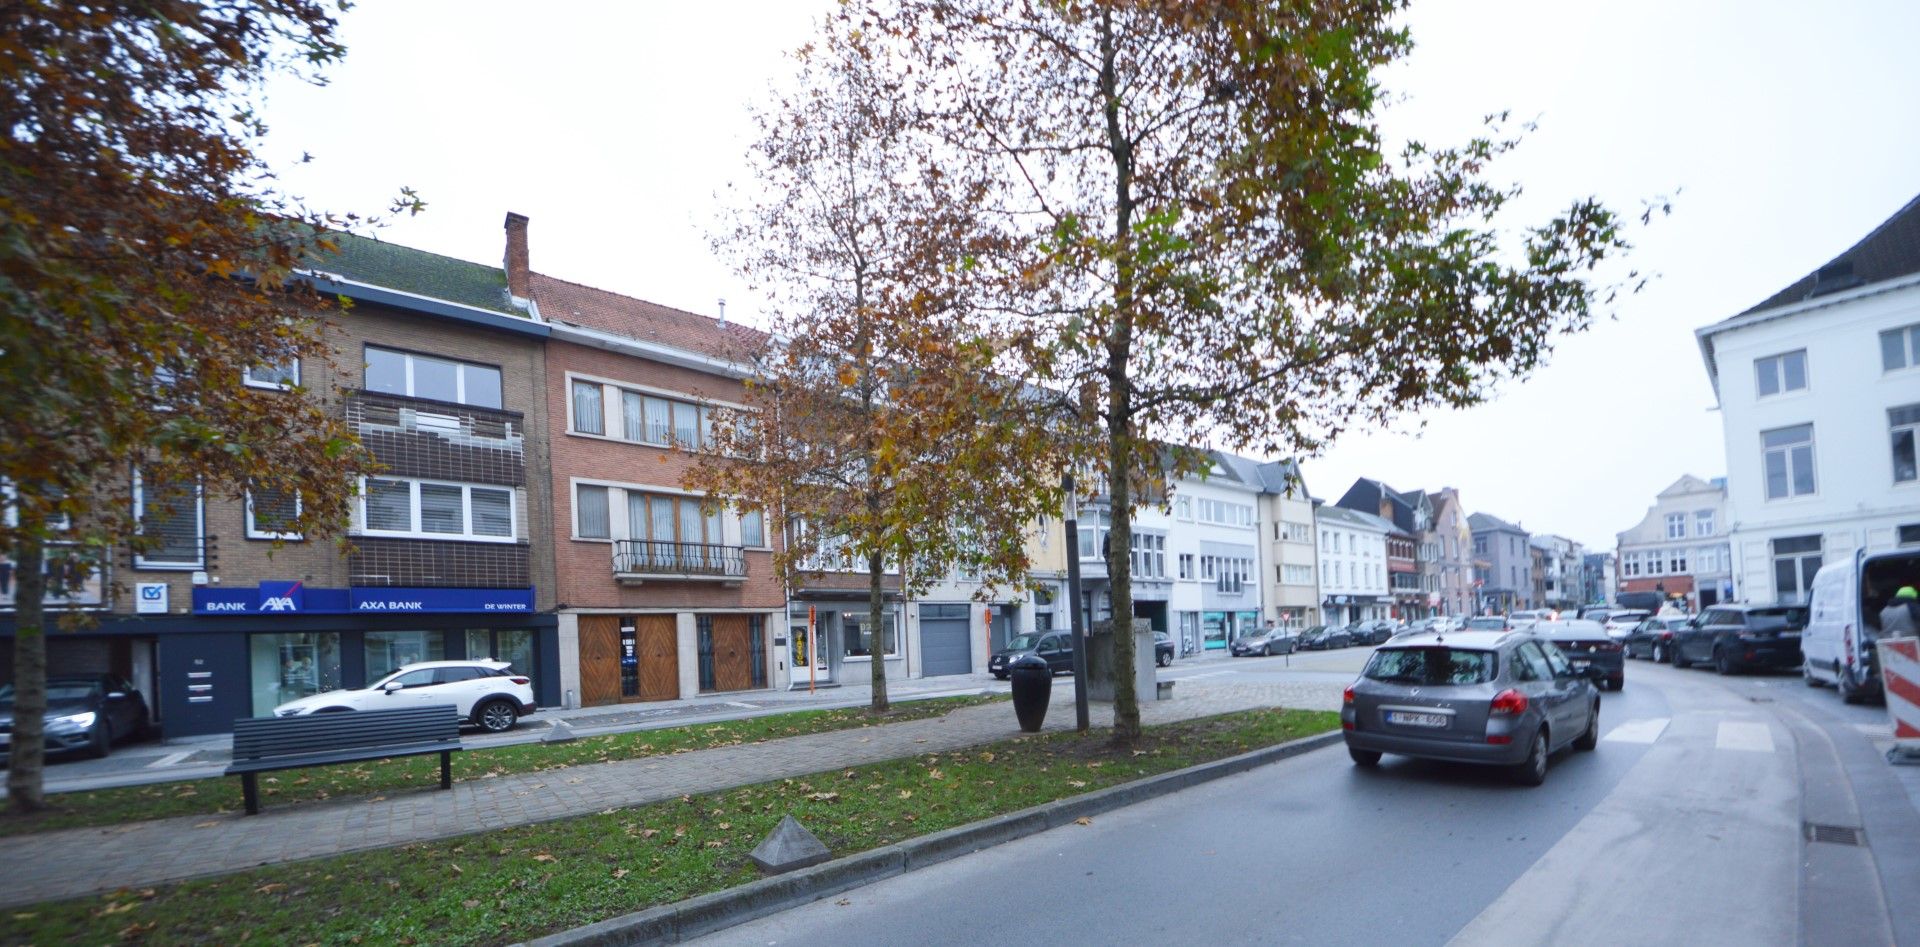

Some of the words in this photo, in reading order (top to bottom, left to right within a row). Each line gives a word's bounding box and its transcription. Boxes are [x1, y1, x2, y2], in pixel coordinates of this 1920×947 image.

[206, 602, 246, 611] BANK
[259, 597, 296, 611] AXA
[359, 601, 386, 610] AXA
[388, 601, 422, 610] BANK
